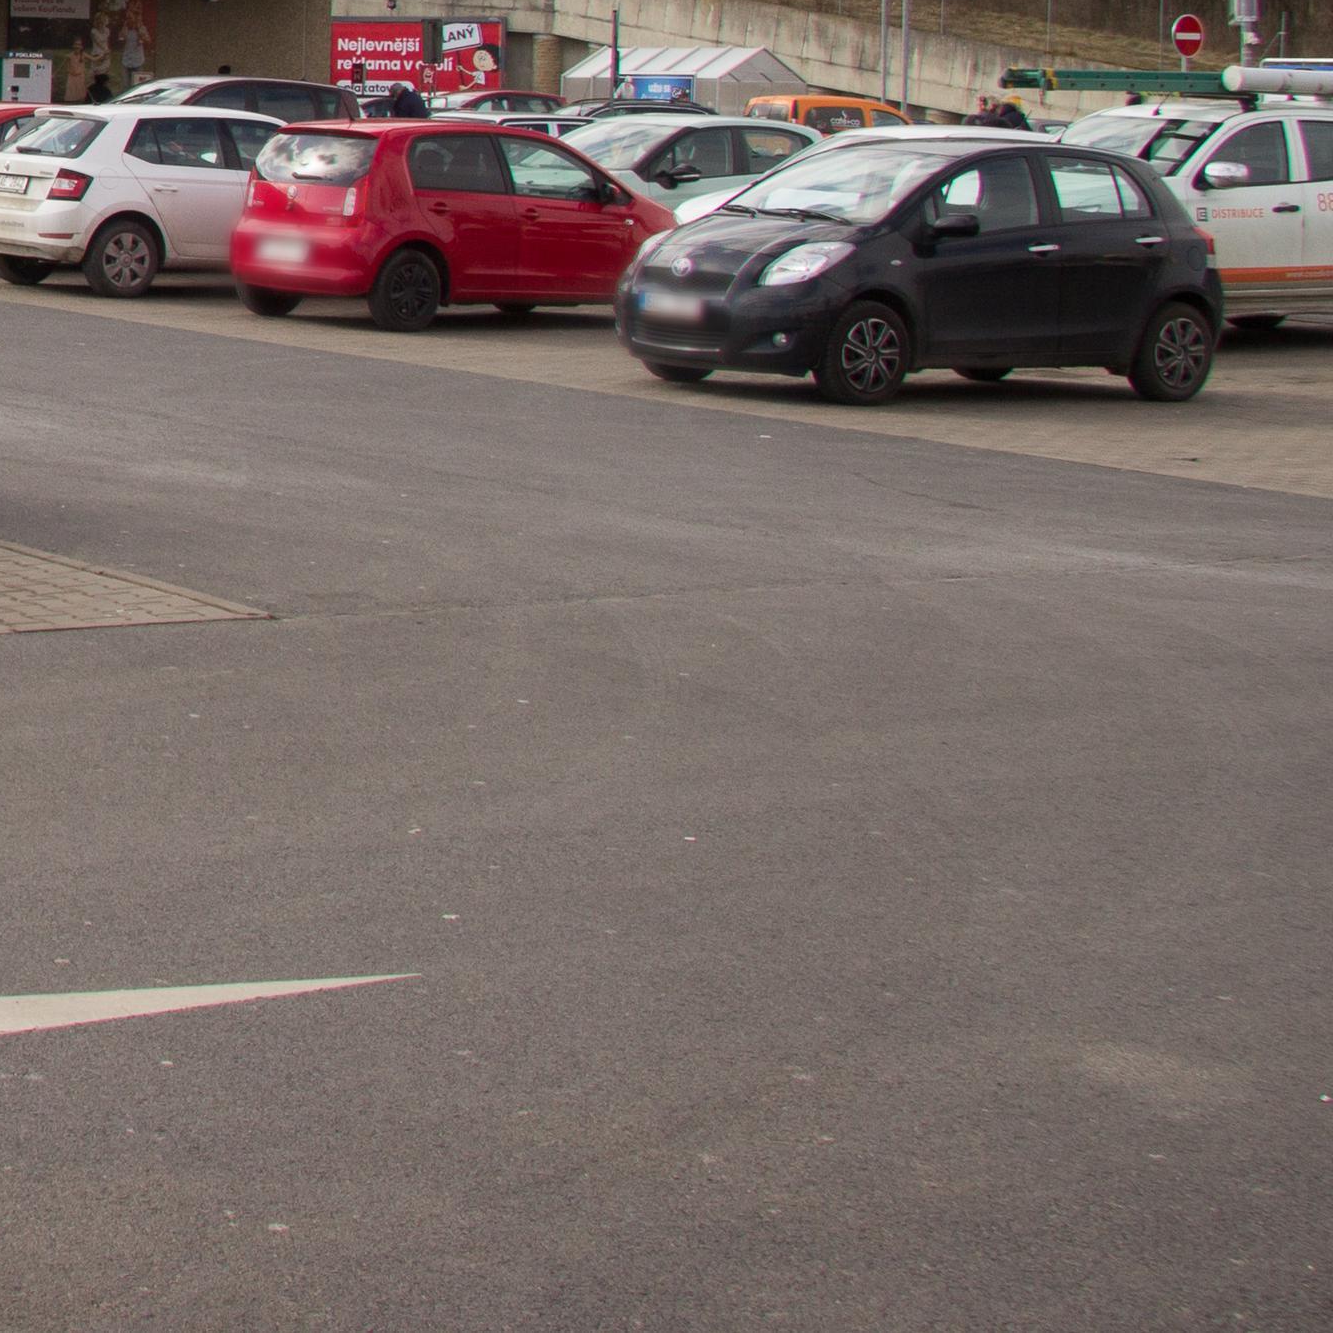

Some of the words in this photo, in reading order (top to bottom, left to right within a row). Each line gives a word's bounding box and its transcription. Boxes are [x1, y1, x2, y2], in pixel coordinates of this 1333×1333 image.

[337, 37, 421, 56] Nejlevnější
[403, 60, 414, 70] v
[1211, 208, 1264, 219] DISTRIBUCE
